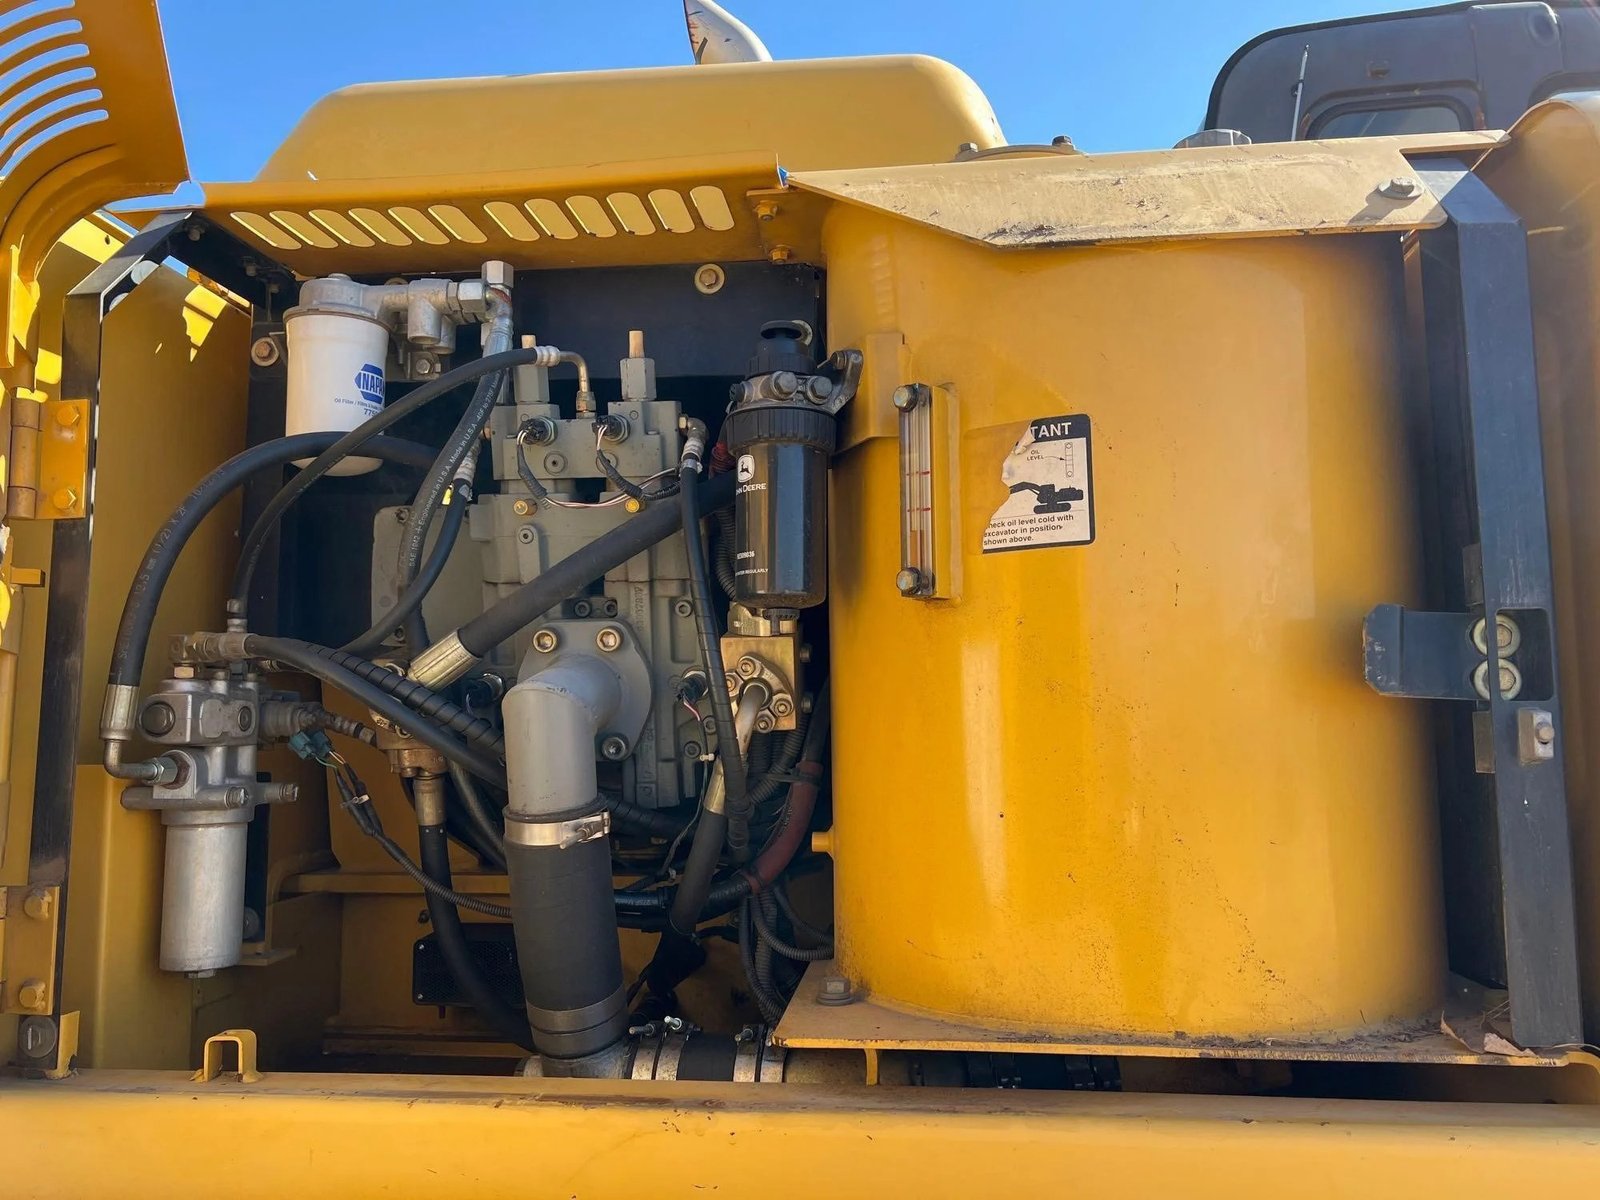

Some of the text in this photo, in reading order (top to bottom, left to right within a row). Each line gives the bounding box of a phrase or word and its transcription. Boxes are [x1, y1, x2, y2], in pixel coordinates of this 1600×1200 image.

[1030, 421, 1072, 438] TANT
[419, 488, 437, 525] Engineered
[449, 446, 463, 463] Made
[743, 483, 767, 493] DEERE
[1007, 519, 1017, 527] oil
[1018, 517, 1037, 526] level
[1037, 515, 1055, 523] cold
[1056, 514, 1074, 522] with
[984, 527, 1018, 537] excavator
[1020, 526, 1028, 534] in
[983, 535, 1034, 546] shown above.
